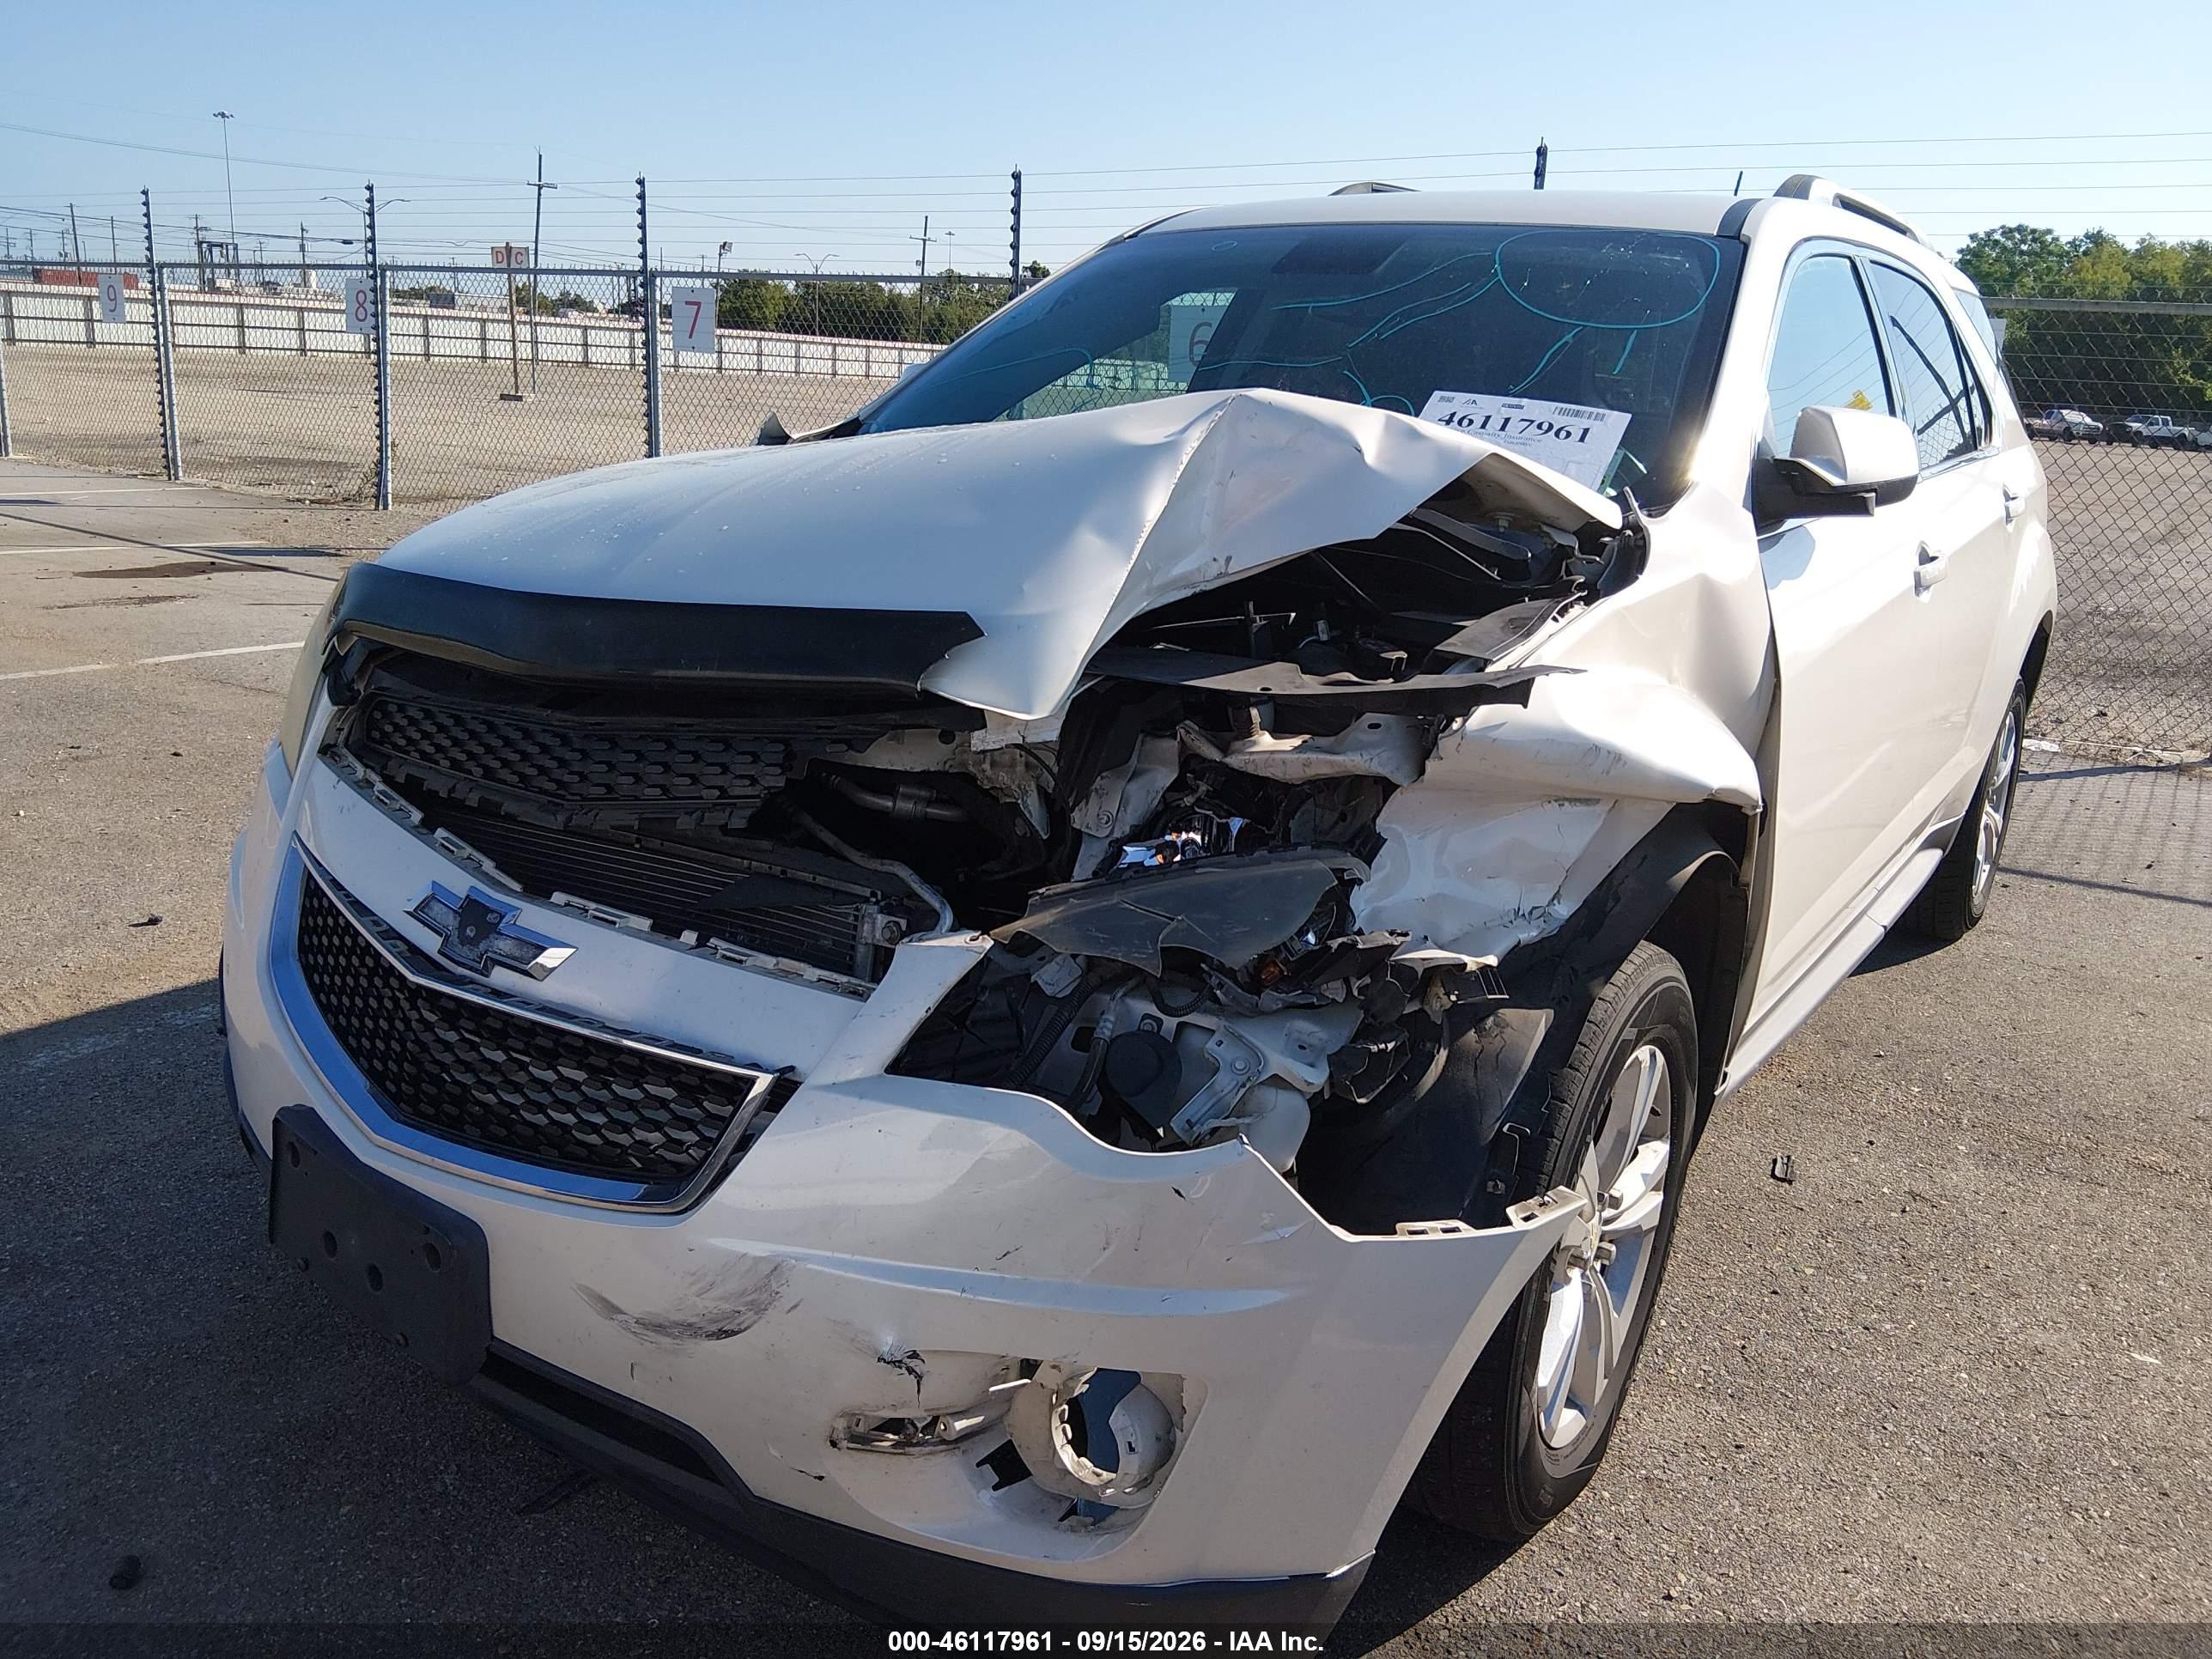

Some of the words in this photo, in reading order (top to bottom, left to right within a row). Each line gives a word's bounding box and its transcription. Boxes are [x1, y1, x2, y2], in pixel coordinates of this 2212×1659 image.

[495, 251, 505, 264] D
[515, 251, 524, 265] C
[106, 284, 118, 313] 9
[355, 289, 368, 323] 8
[684, 301, 702, 339] 7
[1437, 410, 1591, 444] 46117961
